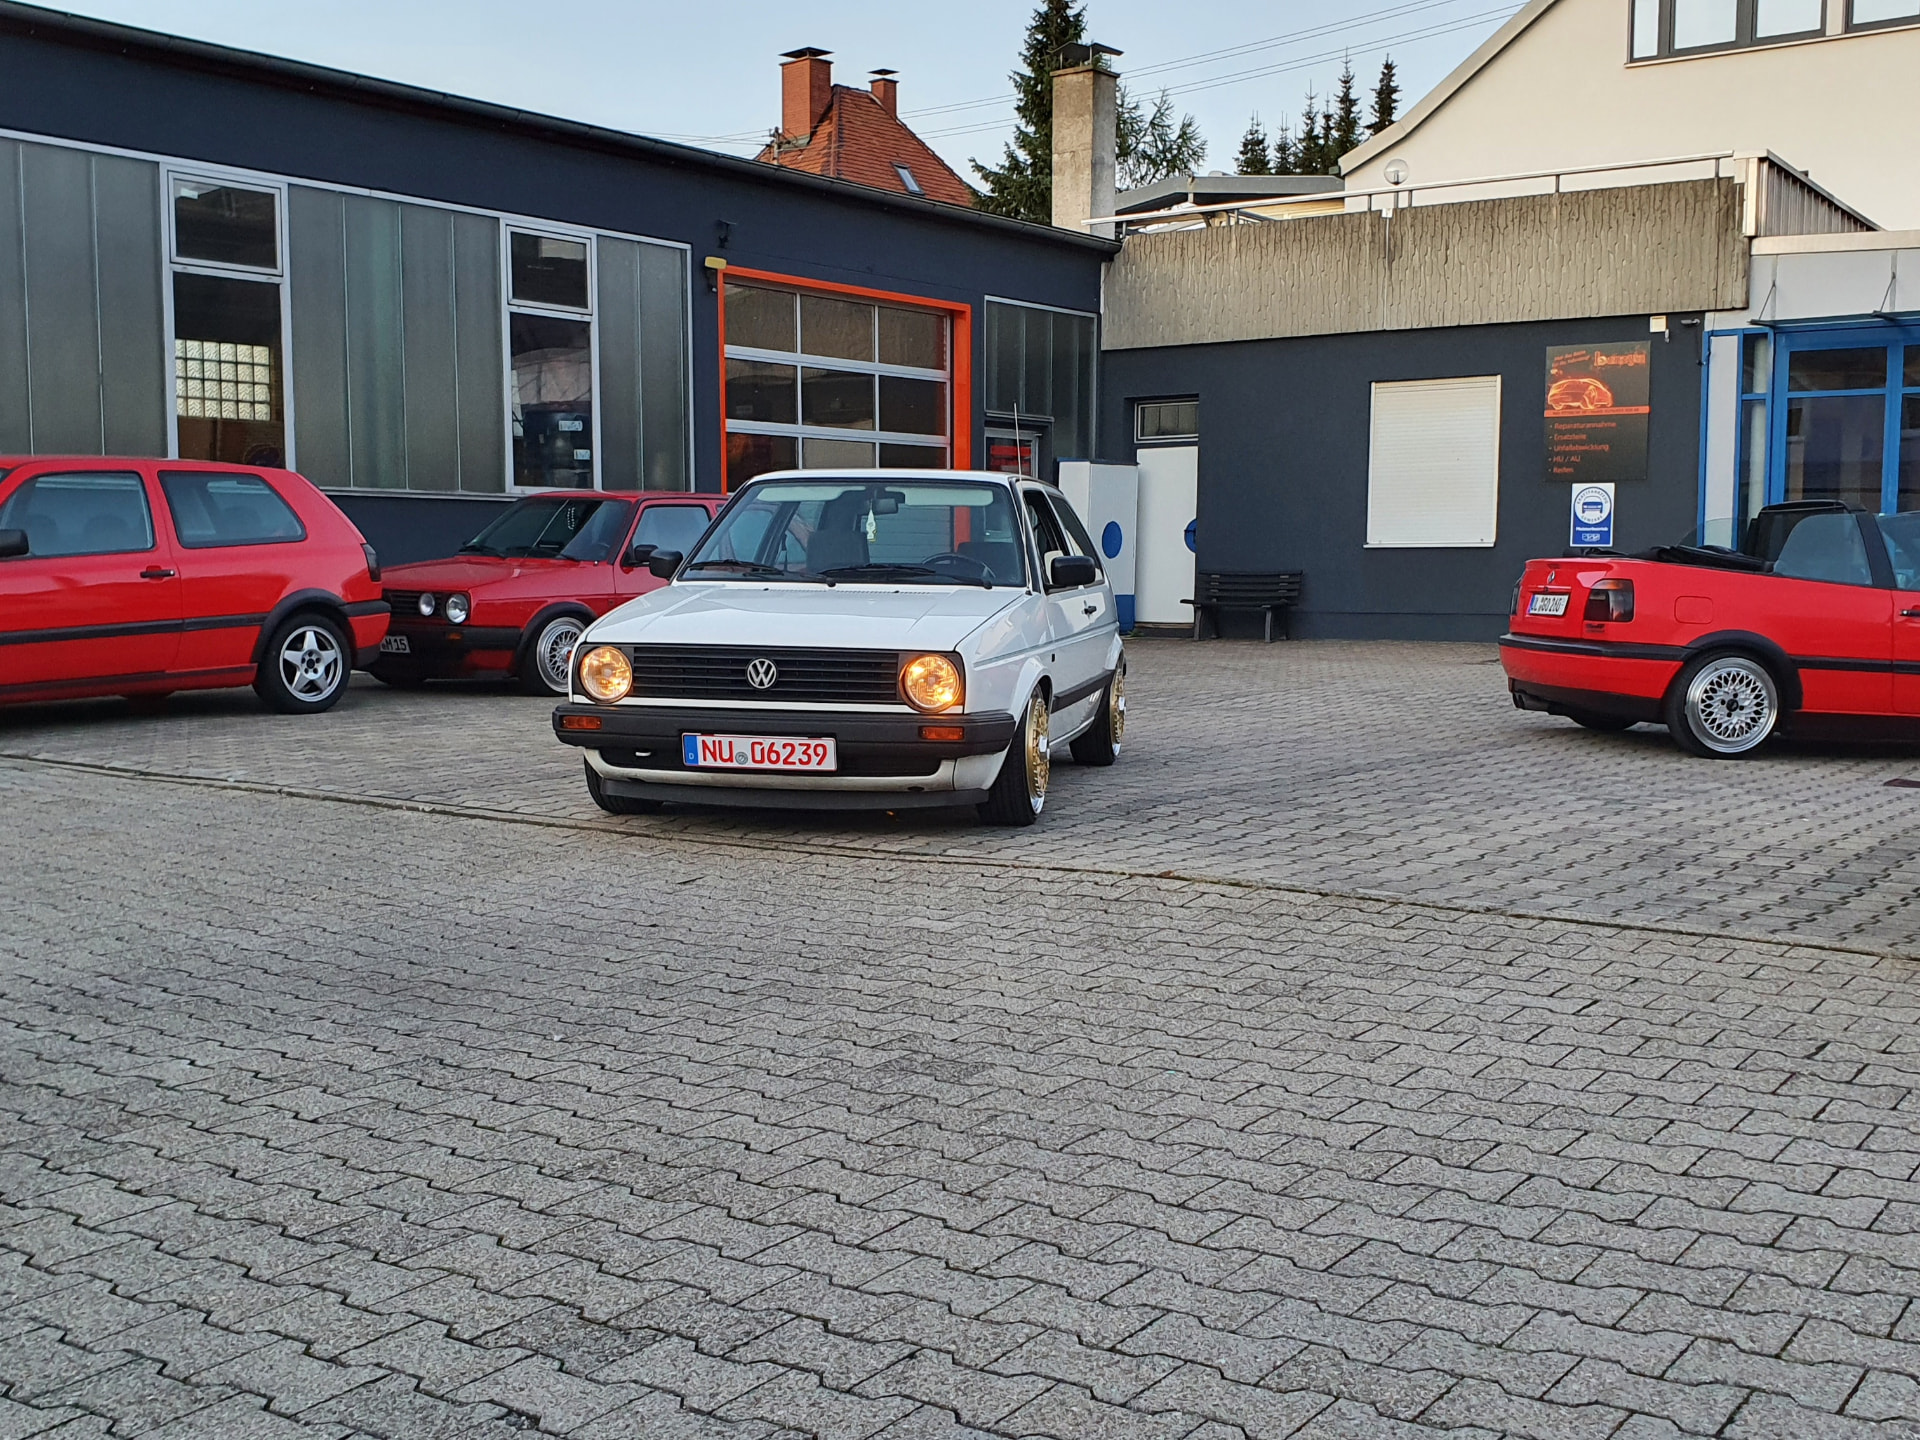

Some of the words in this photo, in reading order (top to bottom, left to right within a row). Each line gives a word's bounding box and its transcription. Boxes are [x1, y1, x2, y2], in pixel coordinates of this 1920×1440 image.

[394, 638, 407, 651] 15
[701, 739, 734, 763] NU
[750, 741, 828, 766] 06239
